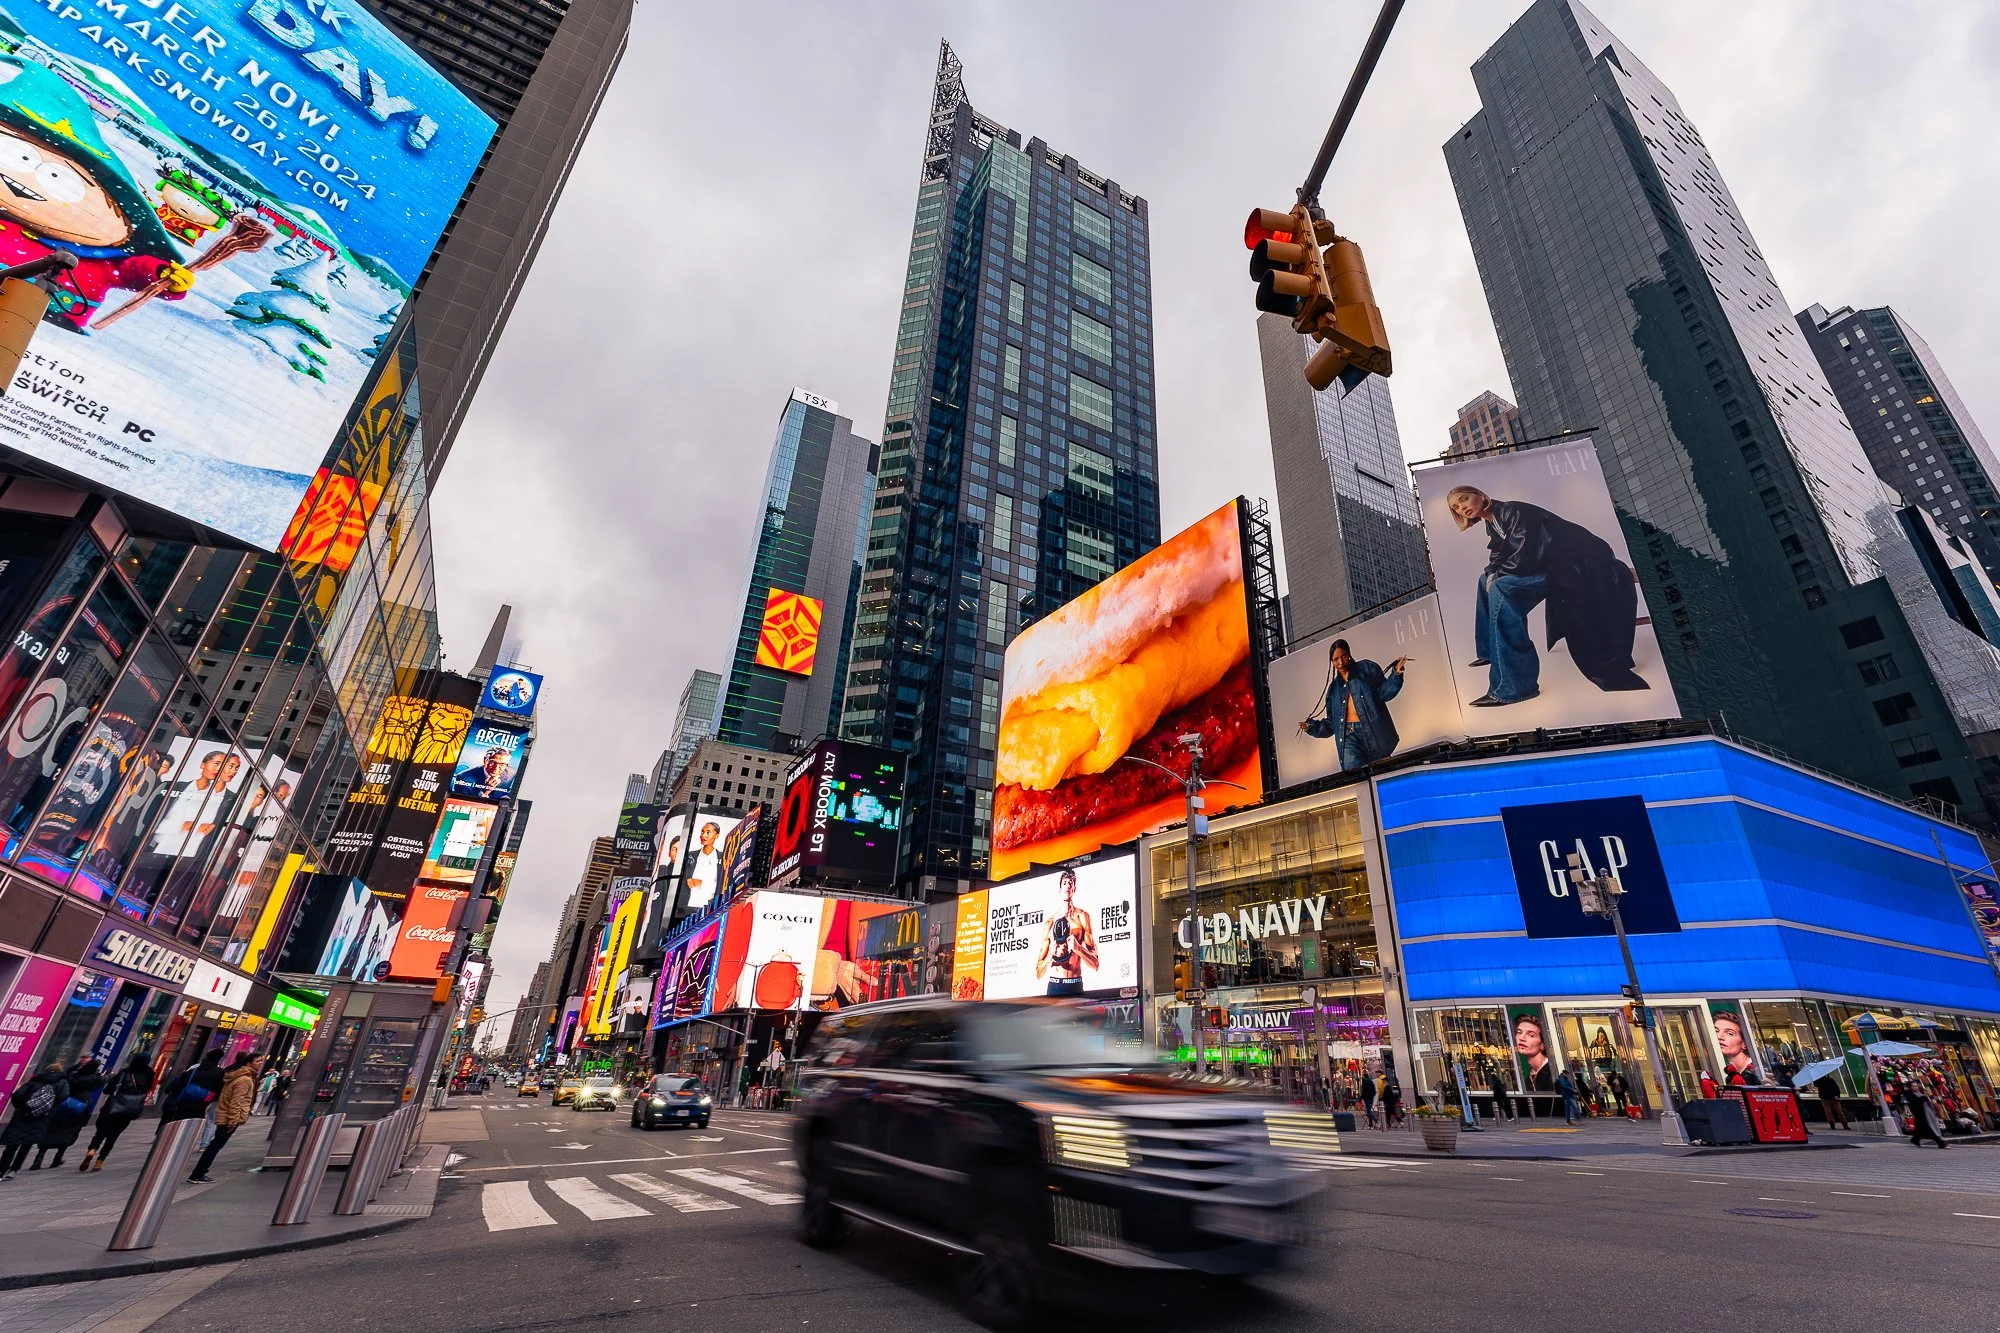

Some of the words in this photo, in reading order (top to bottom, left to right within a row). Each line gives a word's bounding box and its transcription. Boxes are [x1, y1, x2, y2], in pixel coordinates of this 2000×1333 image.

[96, 0, 229, 93] MARCH
[233, 93, 288, 142] 26,
[297, 138, 377, 201] 2024
[238, 59, 341, 142] NOW!
[21, 370, 110, 413] NINTENDO
[805, 392, 829, 409] TSX
[10, 408, 21, 416] of
[20, 411, 56, 431] Comedy
[55, 426, 89, 446] Partners.
[14, 400, 49, 420] Comedy
[49, 414, 84, 435] Partners.
[84, 431, 97, 440] All
[96, 434, 121, 451] Rights
[121, 446, 156, 466] Reserved.
[122, 421, 156, 443] PC
[29, 424, 40, 434] of
[40, 428, 60, 441] THQ
[59, 437, 84, 454] Nordic
[85, 448, 99, 460] AB,
[99, 453, 132, 472] Sweden.
[1546, 446, 1591, 479] GAP
[1393, 608, 1430, 646] GAP
[475, 729, 520, 749] ARCHIE
[823, 751, 836, 773] XL7
[411, 778, 440, 793] SHOW
[421, 769, 439, 783] THE
[397, 796, 439, 814] LIFETIME
[411, 788, 426, 802] OF
[423, 790, 432, 802] A
[813, 774, 833, 830] XBOOM
[381, 841, 425, 854] INGRESSOS
[386, 835, 424, 847] OBTENHA
[616, 837, 650, 851] WICKED
[810, 833, 825, 853] LG
[389, 850, 411, 859] AQUI
[1539, 834, 1628, 898] GAP
[616, 877, 639, 889] LITTLE
[763, 913, 813, 924] COACH
[990, 917, 1016, 931] JUST
[1017, 911, 1044, 926] FLIRT
[991, 904, 1020, 919] DON'T
[1101, 905, 1120, 919] FREE
[1238, 895, 1326, 942] NAVY
[1101, 915, 1127, 930] LETICS
[990, 929, 1015, 943] WITH
[989, 938, 1029, 955] FITNESS
[96, 929, 197, 985] SKECHERS
[10, 992, 44, 1012] FLAGSHIP
[0, 1013, 25, 1032] RETAIL
[20, 1016, 44, 1034] SPACE
[320, 996, 343, 1039] Newsstand
[1229, 1014, 1253, 1029] OLD
[1254, 1011, 1291, 1028] NAVY
[1, 1036, 26, 1054] LEASE
